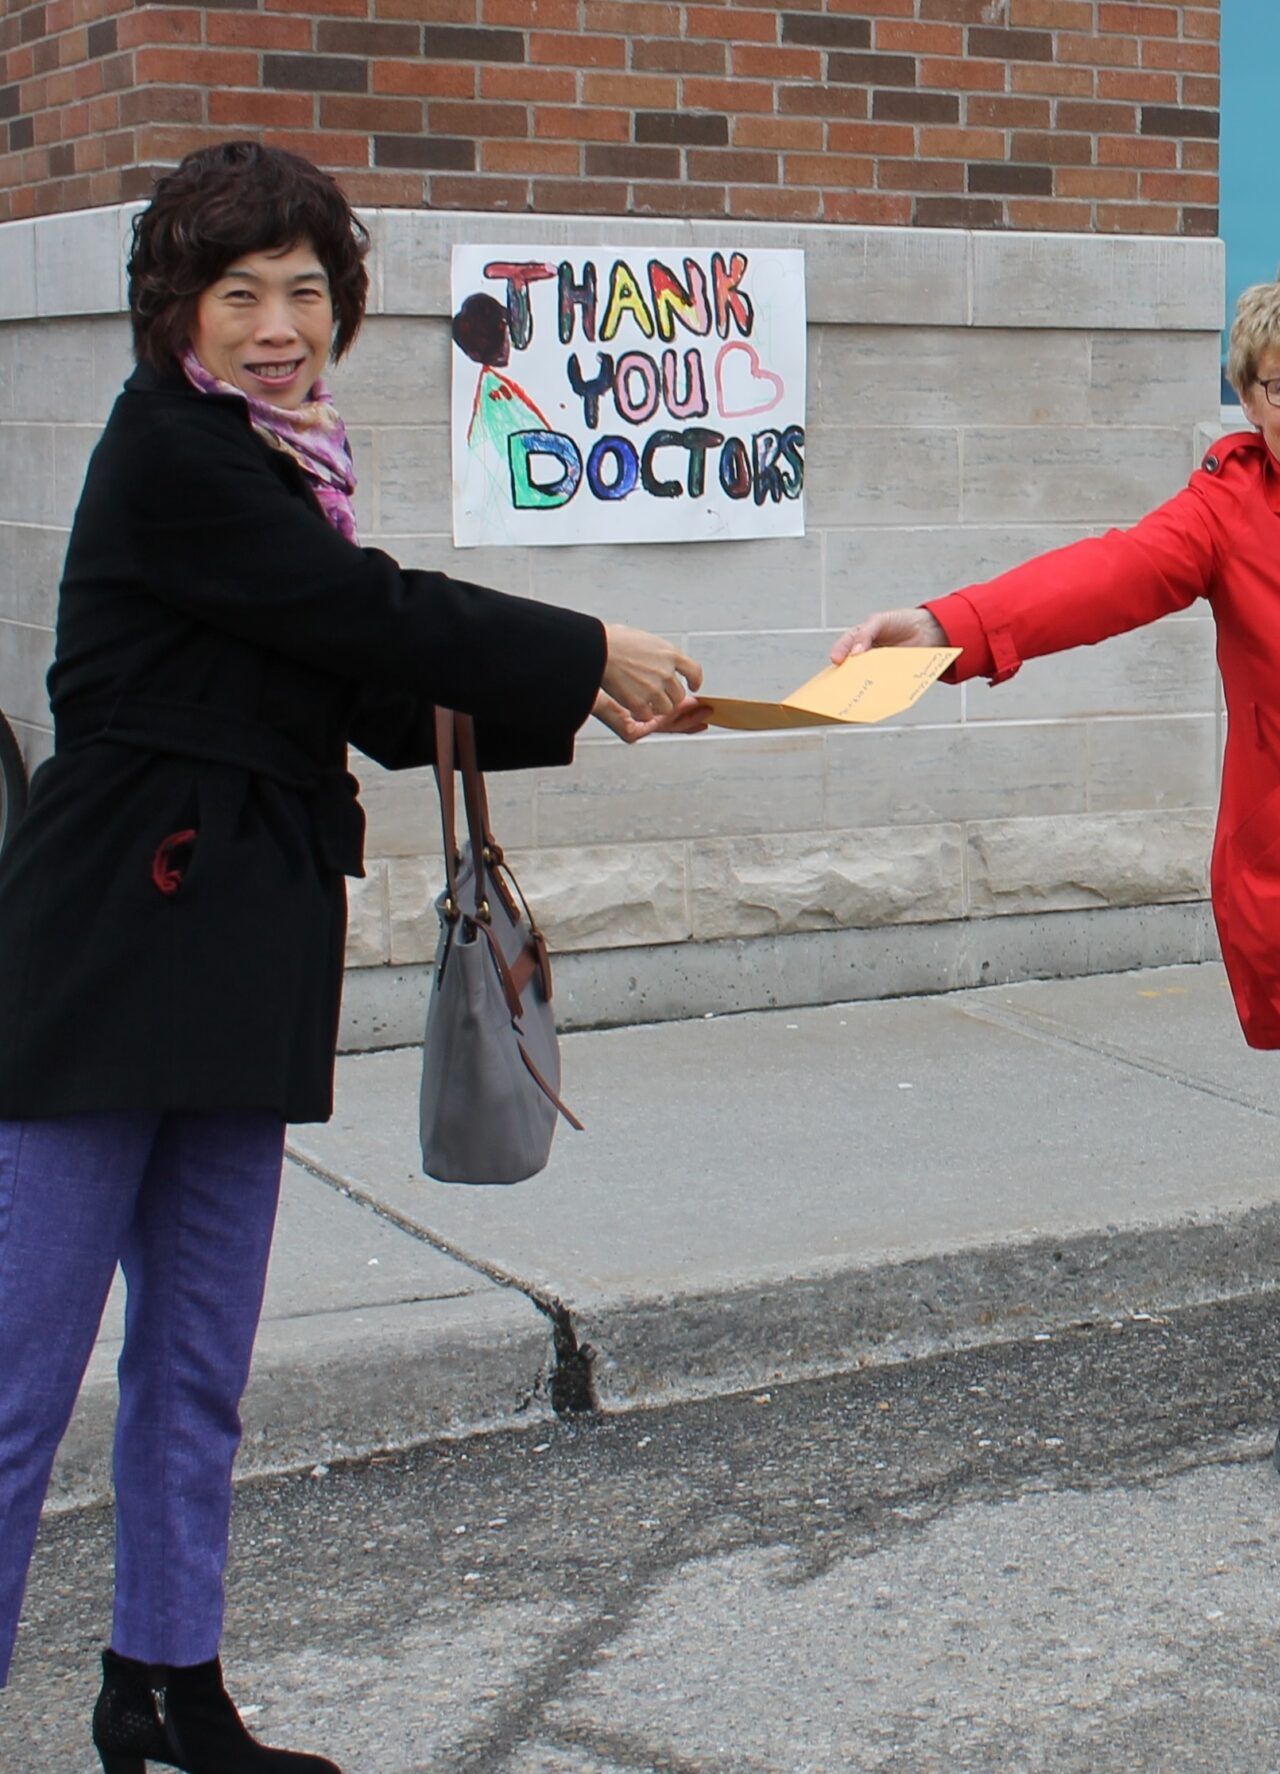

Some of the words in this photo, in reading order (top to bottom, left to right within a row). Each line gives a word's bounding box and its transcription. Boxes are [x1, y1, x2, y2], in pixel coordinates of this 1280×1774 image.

[483, 251, 754, 351] THANK
[567, 347, 709, 430] YOU
[507, 424, 805, 510] DOCTORS
